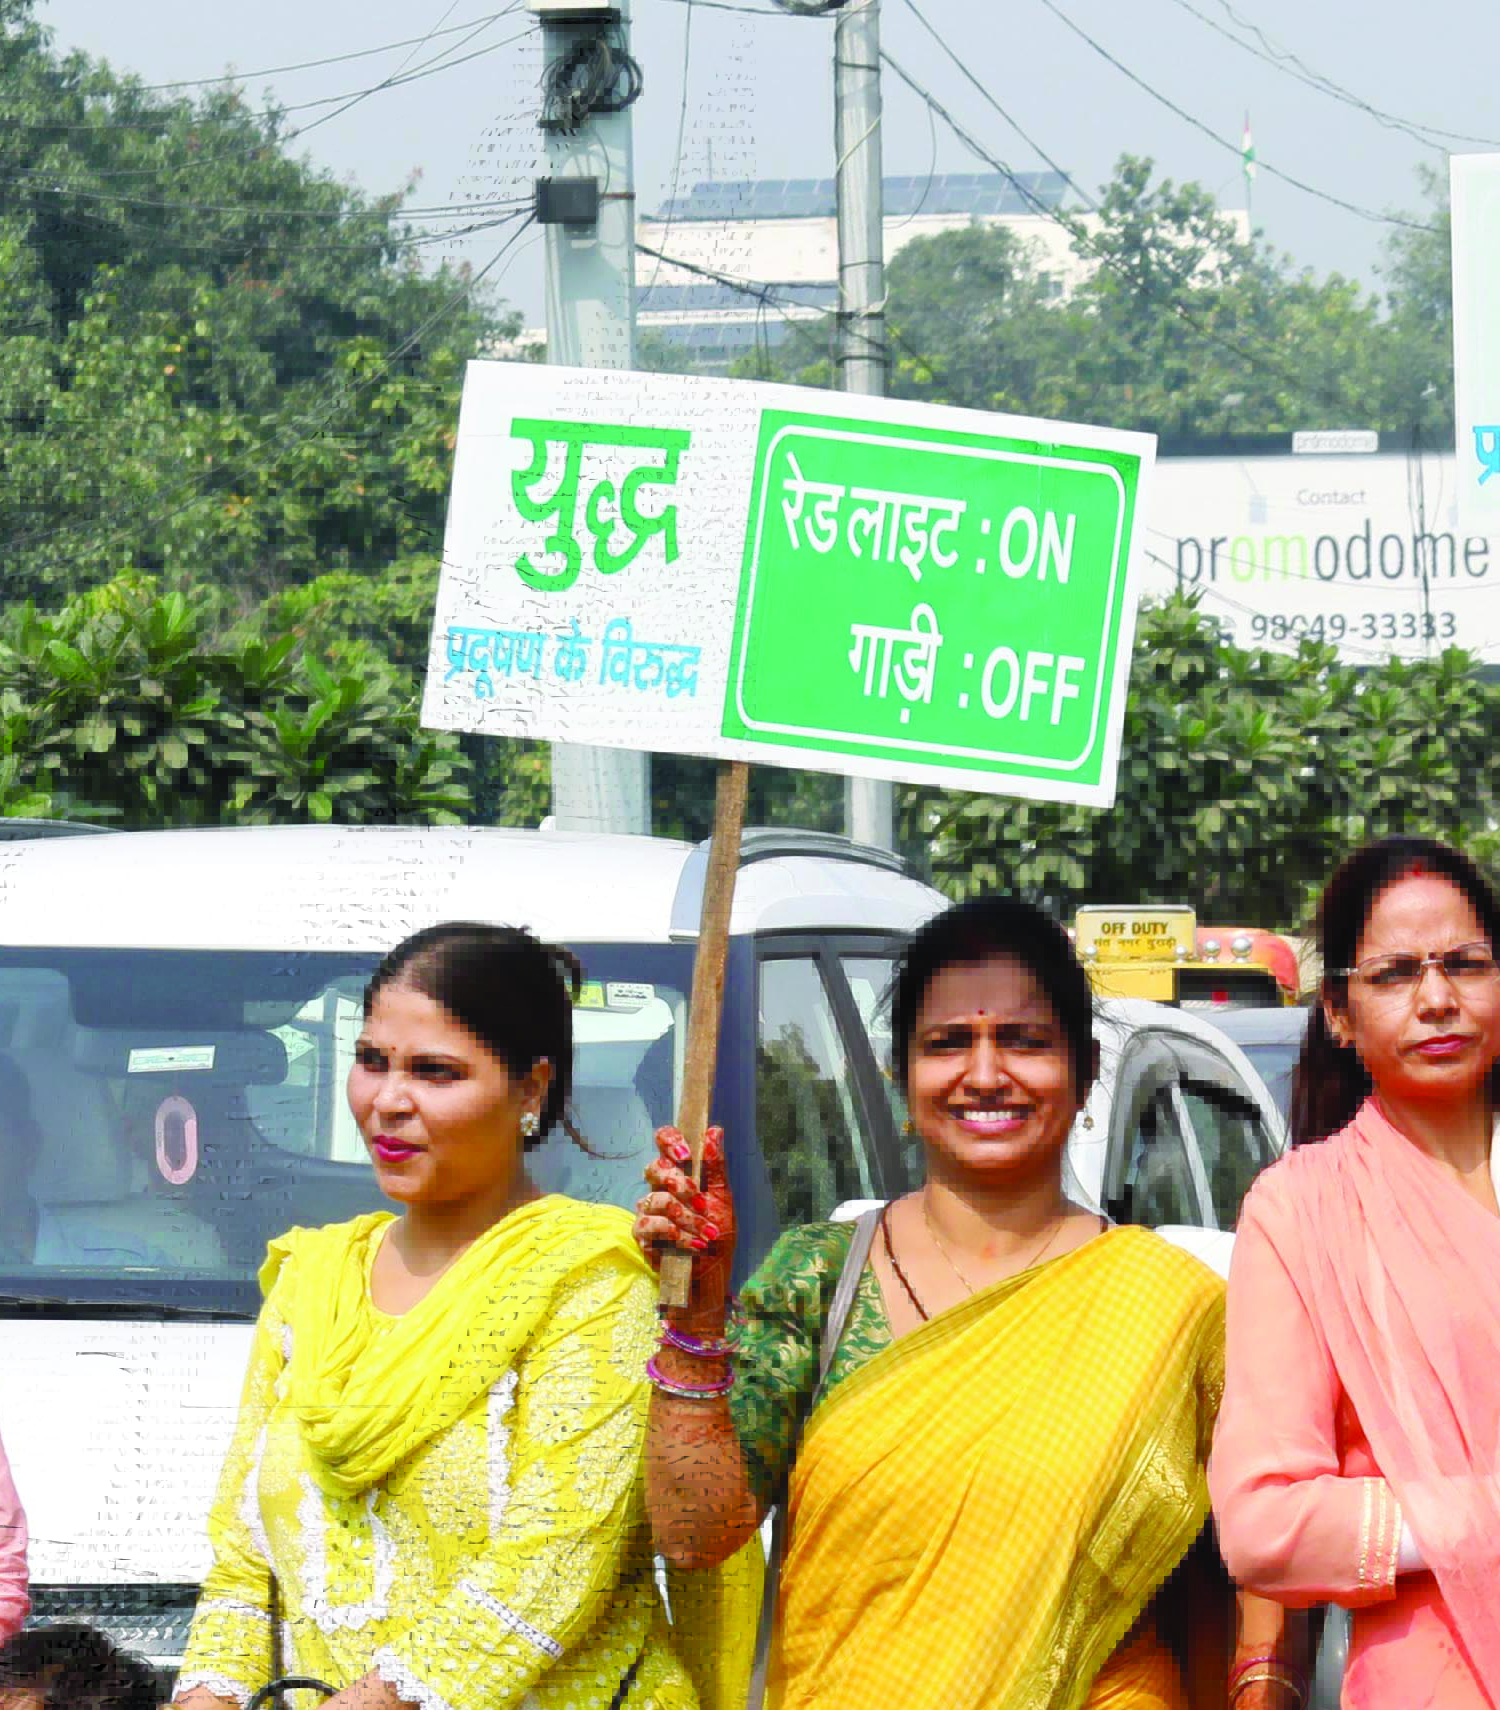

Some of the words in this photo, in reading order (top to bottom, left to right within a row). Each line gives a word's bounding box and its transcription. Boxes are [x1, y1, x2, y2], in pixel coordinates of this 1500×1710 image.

[510, 418, 691, 592] युद्ध
[1296, 488, 1367, 506] Contact
[1176, 518, 1490, 583] promodome
[444, 626, 548, 698] प्रदूषण
[554, 618, 592, 682] के
[599, 618, 701, 698] विरुद्ध
[849, 603, 943, 723] गाड़ी
[1101, 922, 1127, 934] OFF
[1132, 922, 1168, 935] DUTY
